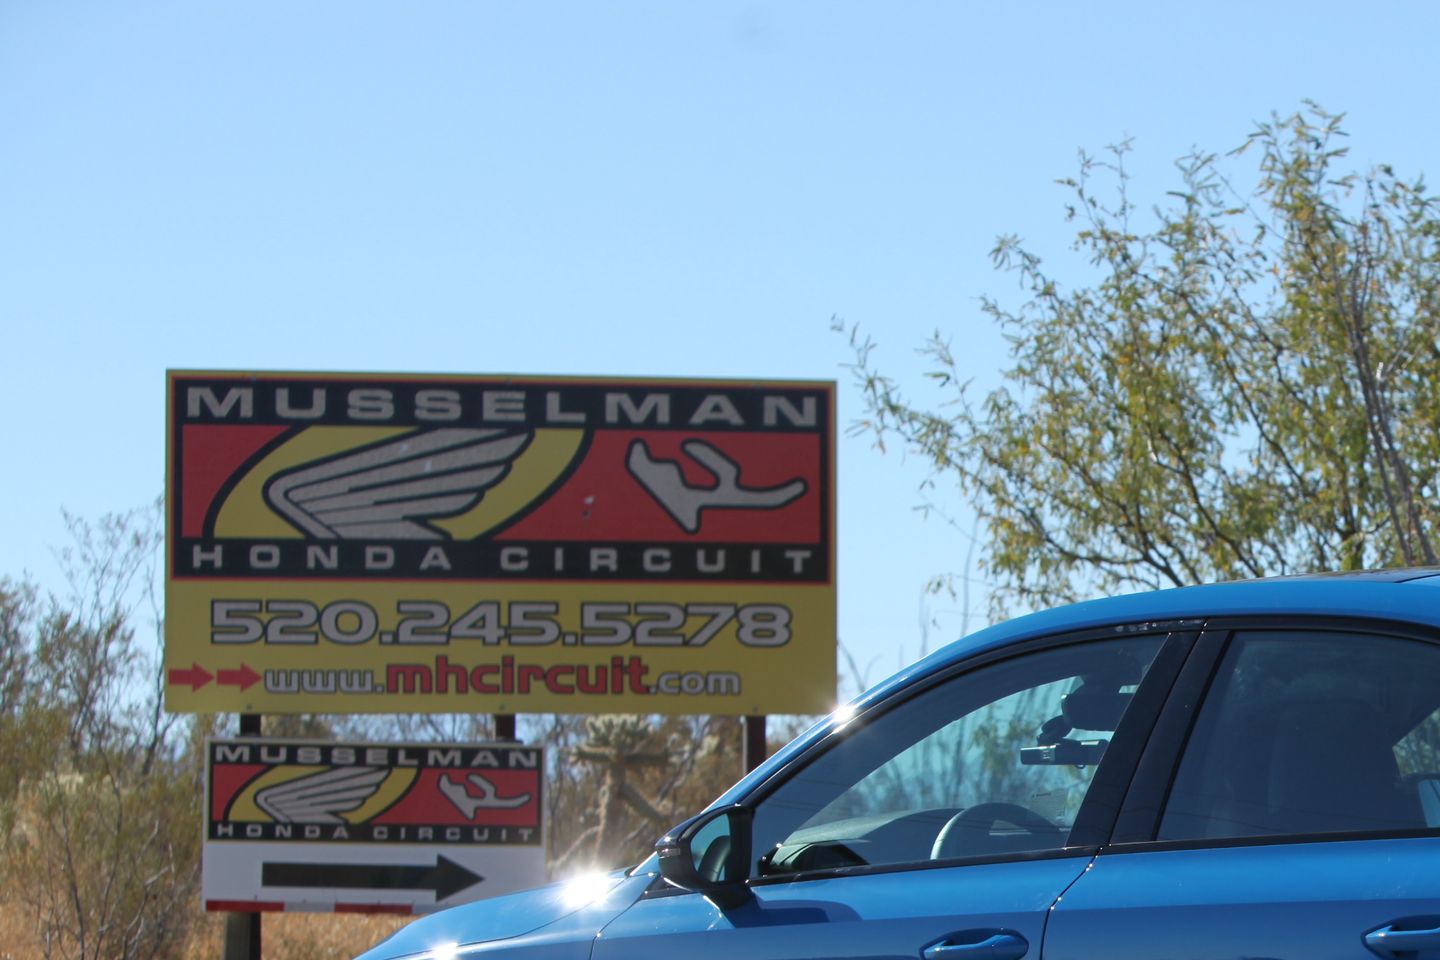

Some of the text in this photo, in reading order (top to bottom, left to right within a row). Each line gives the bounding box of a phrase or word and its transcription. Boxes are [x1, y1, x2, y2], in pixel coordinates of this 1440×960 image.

[186, 385, 817, 427] MUSSELMAN
[191, 544, 812, 574] HONDA CIRCUIT
[210, 598, 793, 648] 520.245.5278
[263, 655, 742, 696] www.mhcircuit.com
[215, 745, 537, 767] MUSSELMAN
[217, 824, 534, 842] HONDA CIRCUIT
